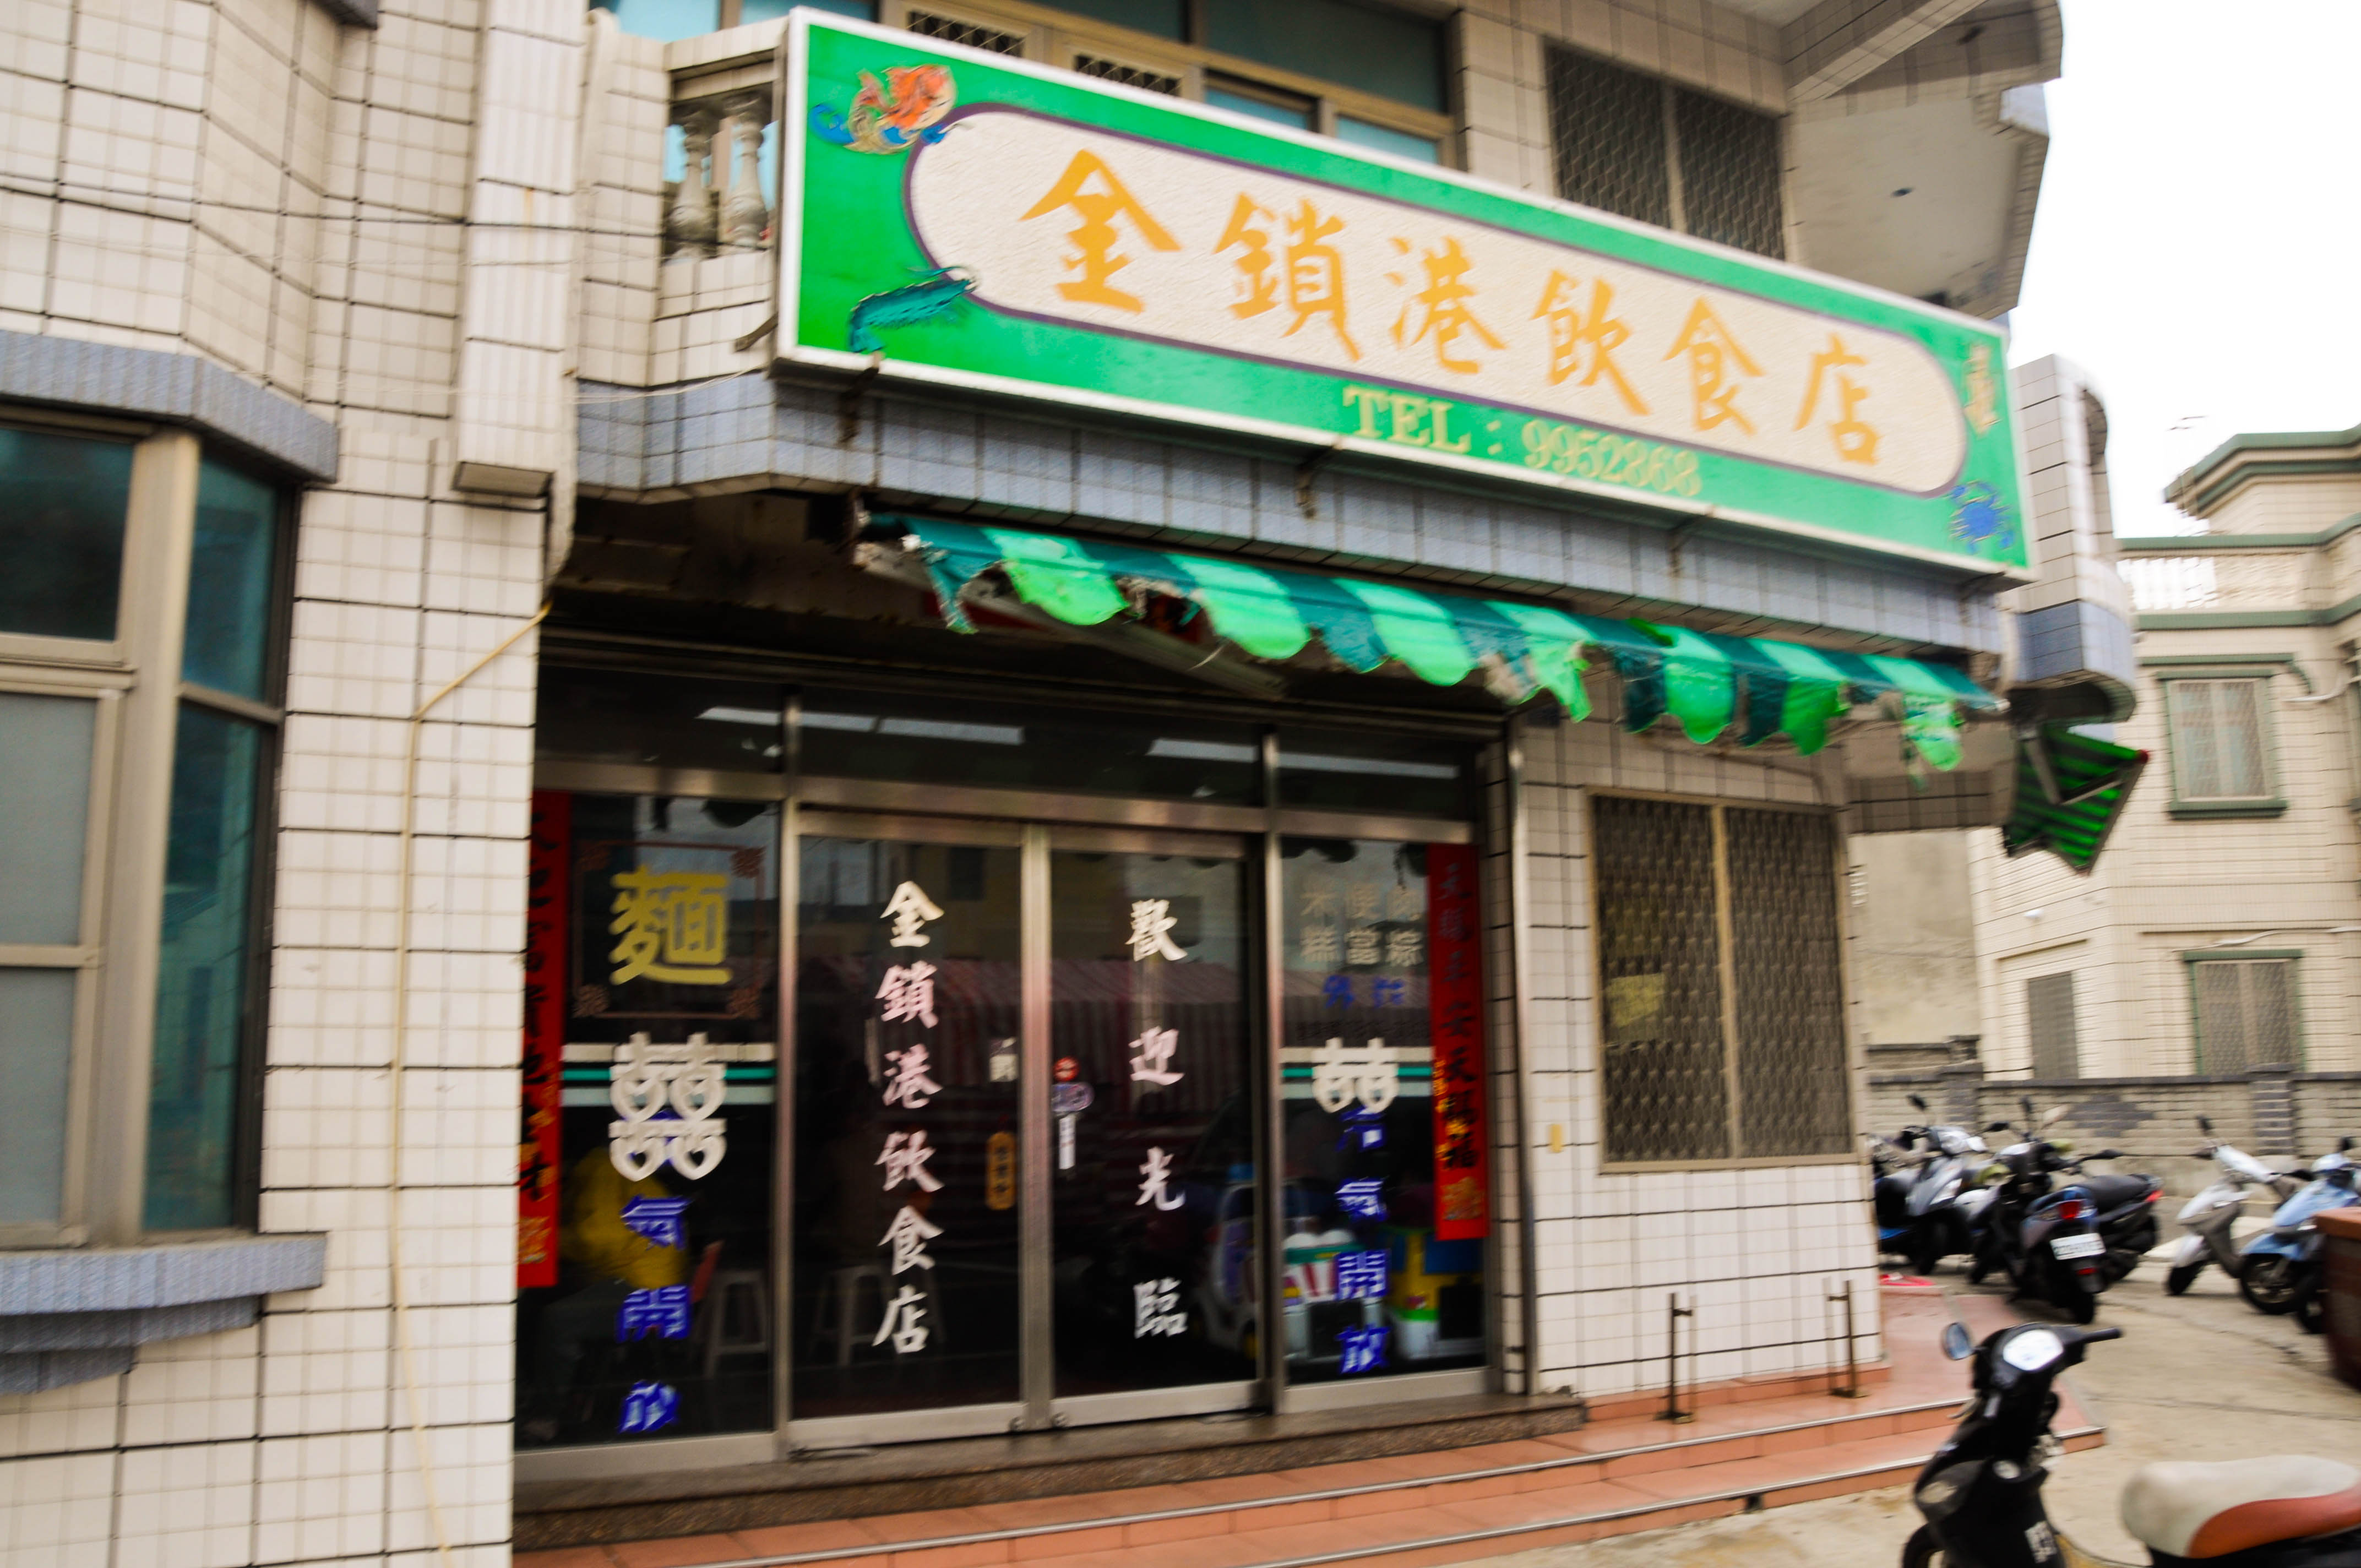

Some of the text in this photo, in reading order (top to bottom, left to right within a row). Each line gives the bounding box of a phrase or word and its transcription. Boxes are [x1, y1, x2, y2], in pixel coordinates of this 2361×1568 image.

[1021, 149, 1880, 465] 金鎖港飲食店
[1521, 418, 1703, 497] 9952868
[609, 864, 735, 986] 麵
[615, 1108, 695, 1434] 氣開放
[872, 880, 945, 1355] 金鎖港飲食店
[1124, 897, 1190, 1340] 歡迎光臨
